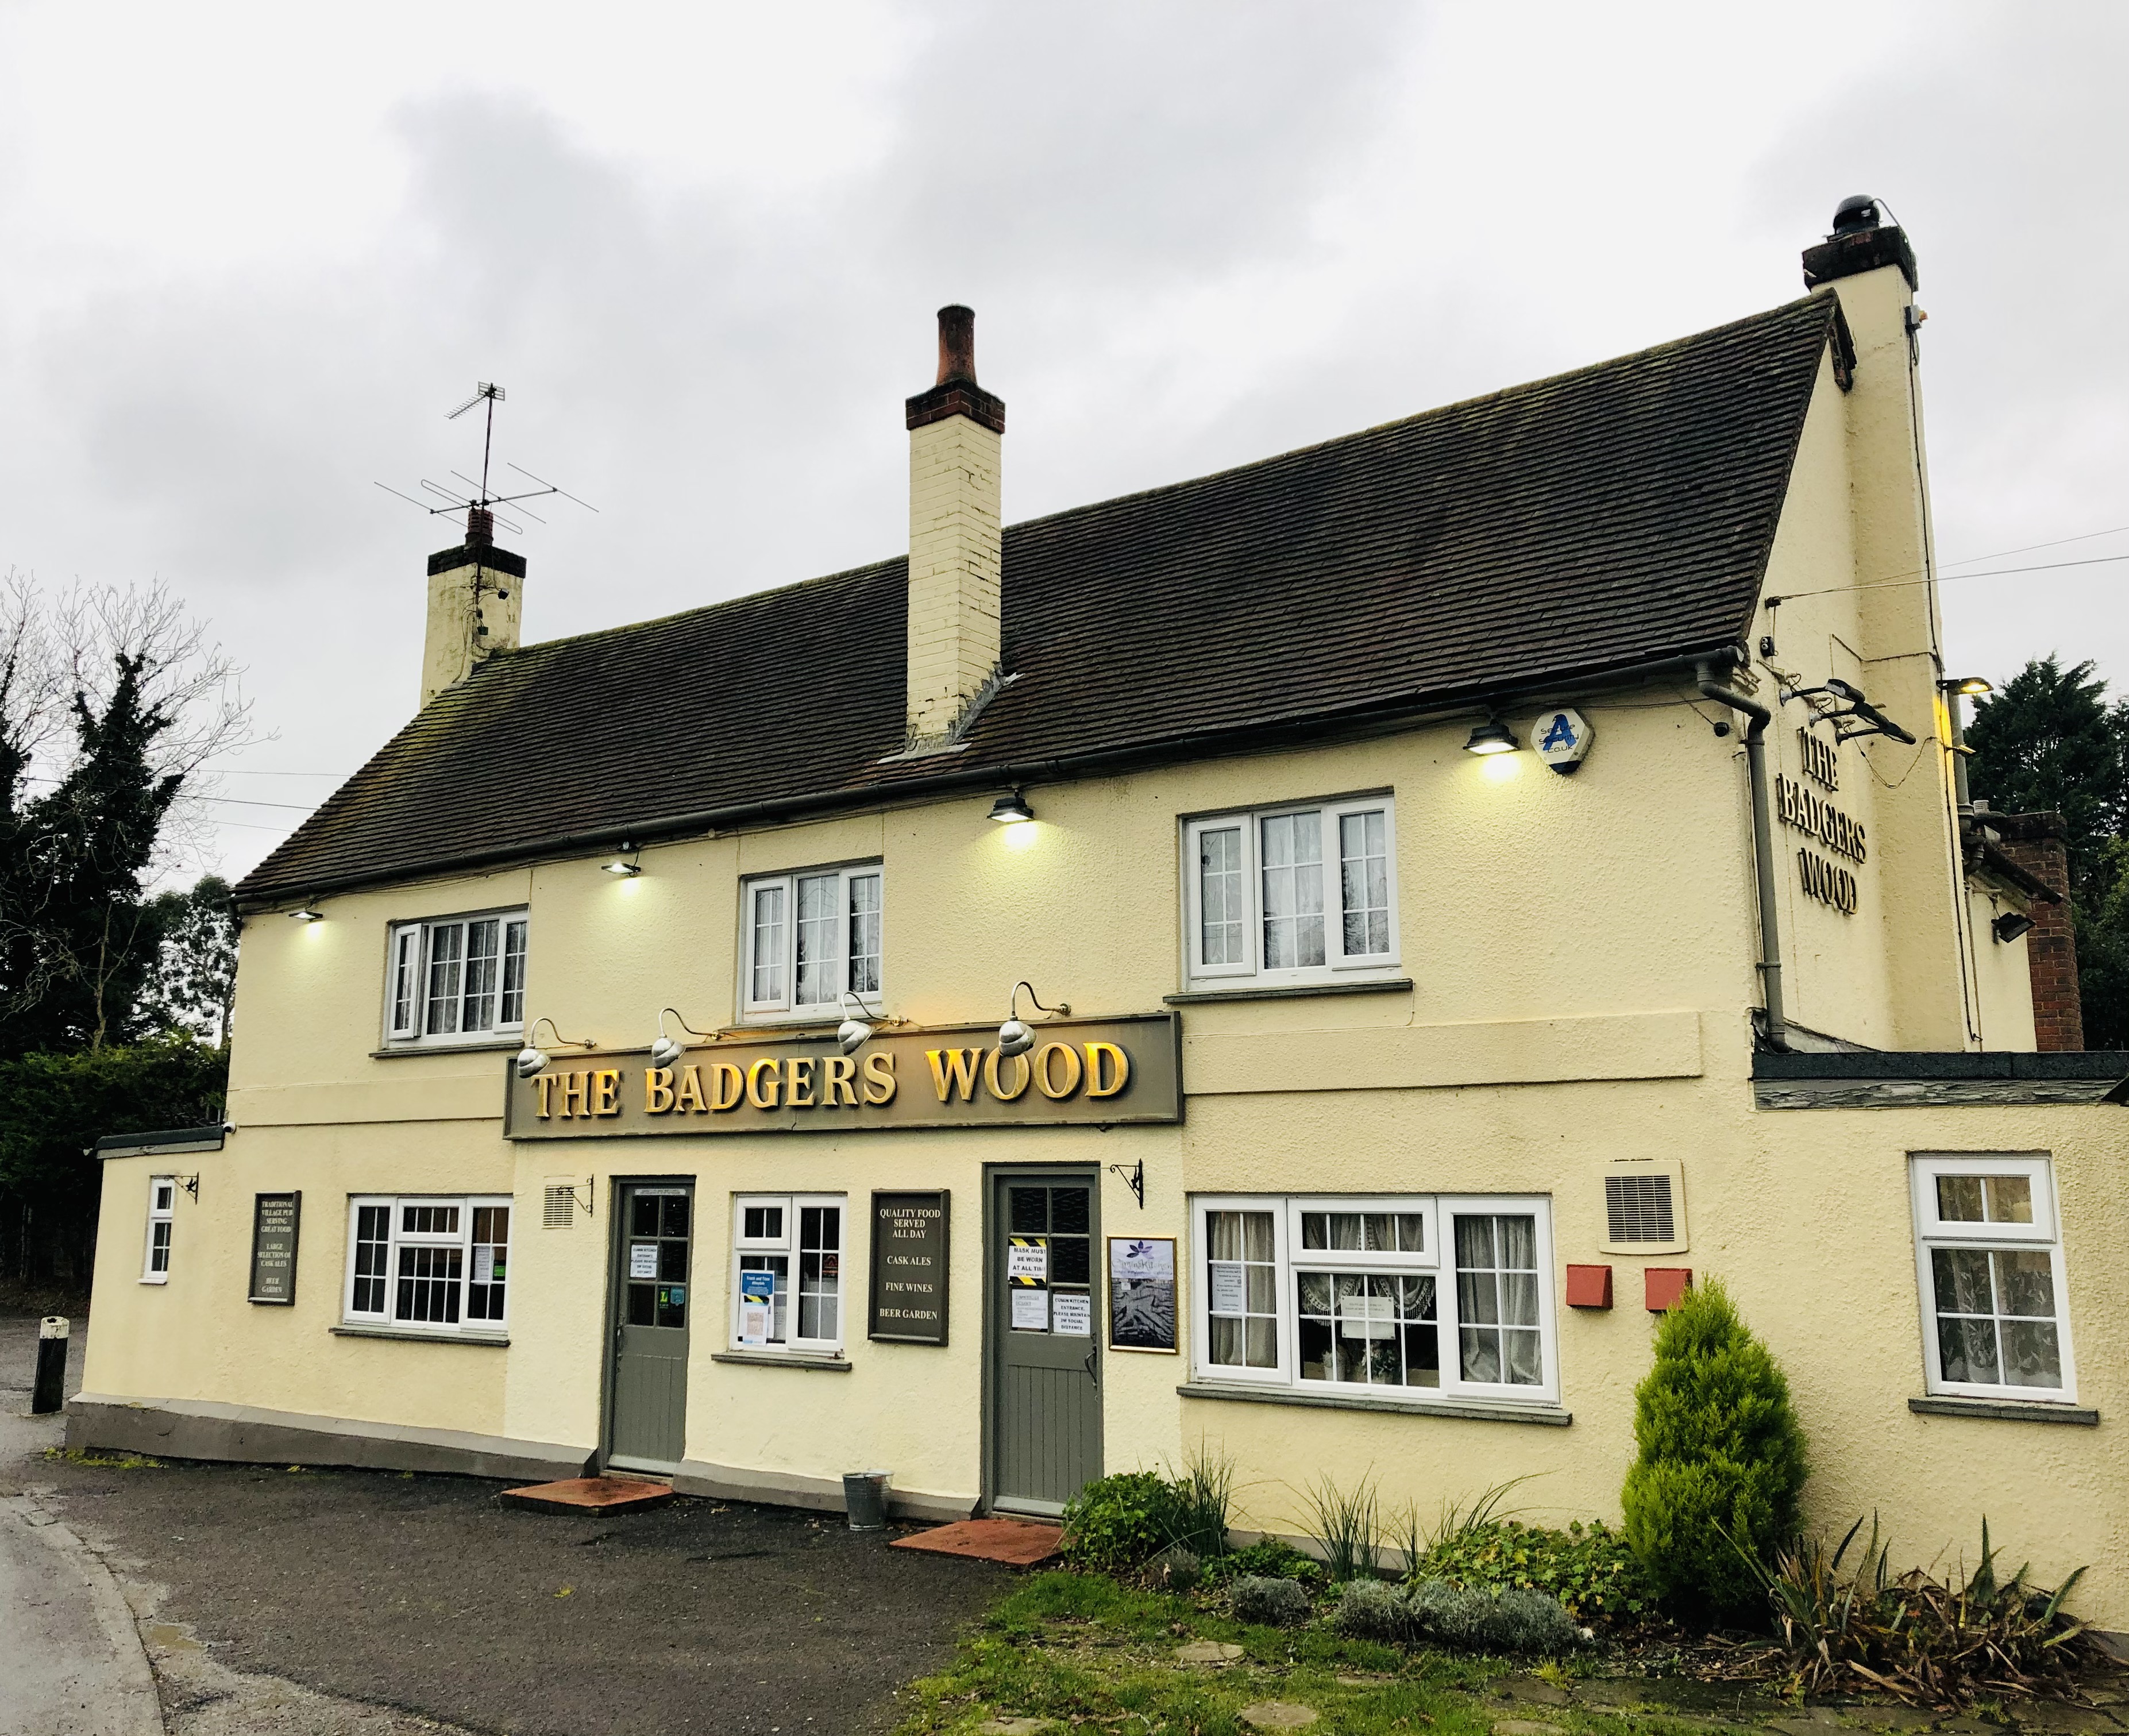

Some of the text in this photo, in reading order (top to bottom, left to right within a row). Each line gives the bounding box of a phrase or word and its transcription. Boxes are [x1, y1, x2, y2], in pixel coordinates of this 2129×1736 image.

[1798, 726, 1839, 792] THE
[1777, 773, 1867, 864] BADGERS
[1799, 847, 1859, 915] WOOD
[530, 1041, 1129, 1118] THE BADGERS WOOD
[880, 1209, 940, 1218] QUALITY FOOD
[893, 1219, 925, 1228] SERVED
[892, 1230, 927, 1239] ALL DAY
[886, 1256, 931, 1266] CASK ALES
[885, 1282, 933, 1293] FINE WINES
[880, 1308, 938, 1320] BEER GARDEN
